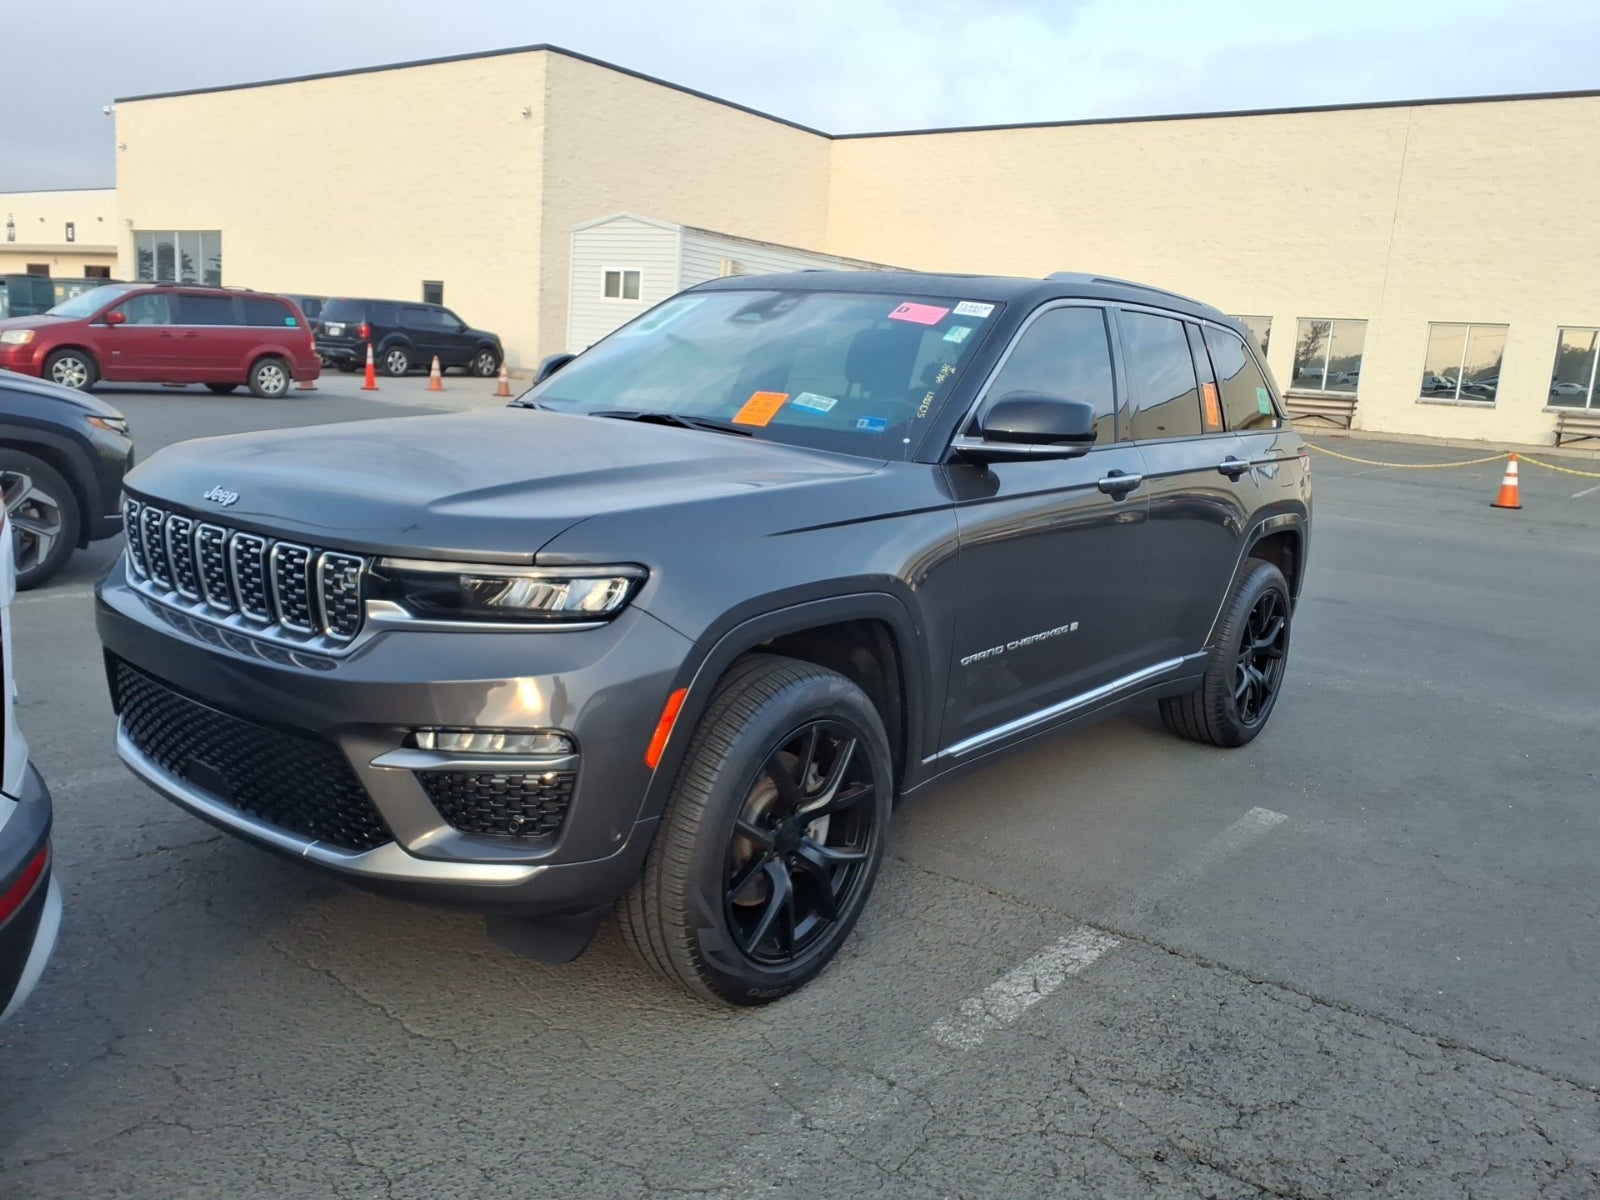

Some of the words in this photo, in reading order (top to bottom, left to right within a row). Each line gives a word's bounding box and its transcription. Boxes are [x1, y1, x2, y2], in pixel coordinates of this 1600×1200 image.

[204, 485, 238, 506] Jeep
[961, 645, 1004, 666] GRAND
[1006, 625, 1069, 651] CHEROKEE
